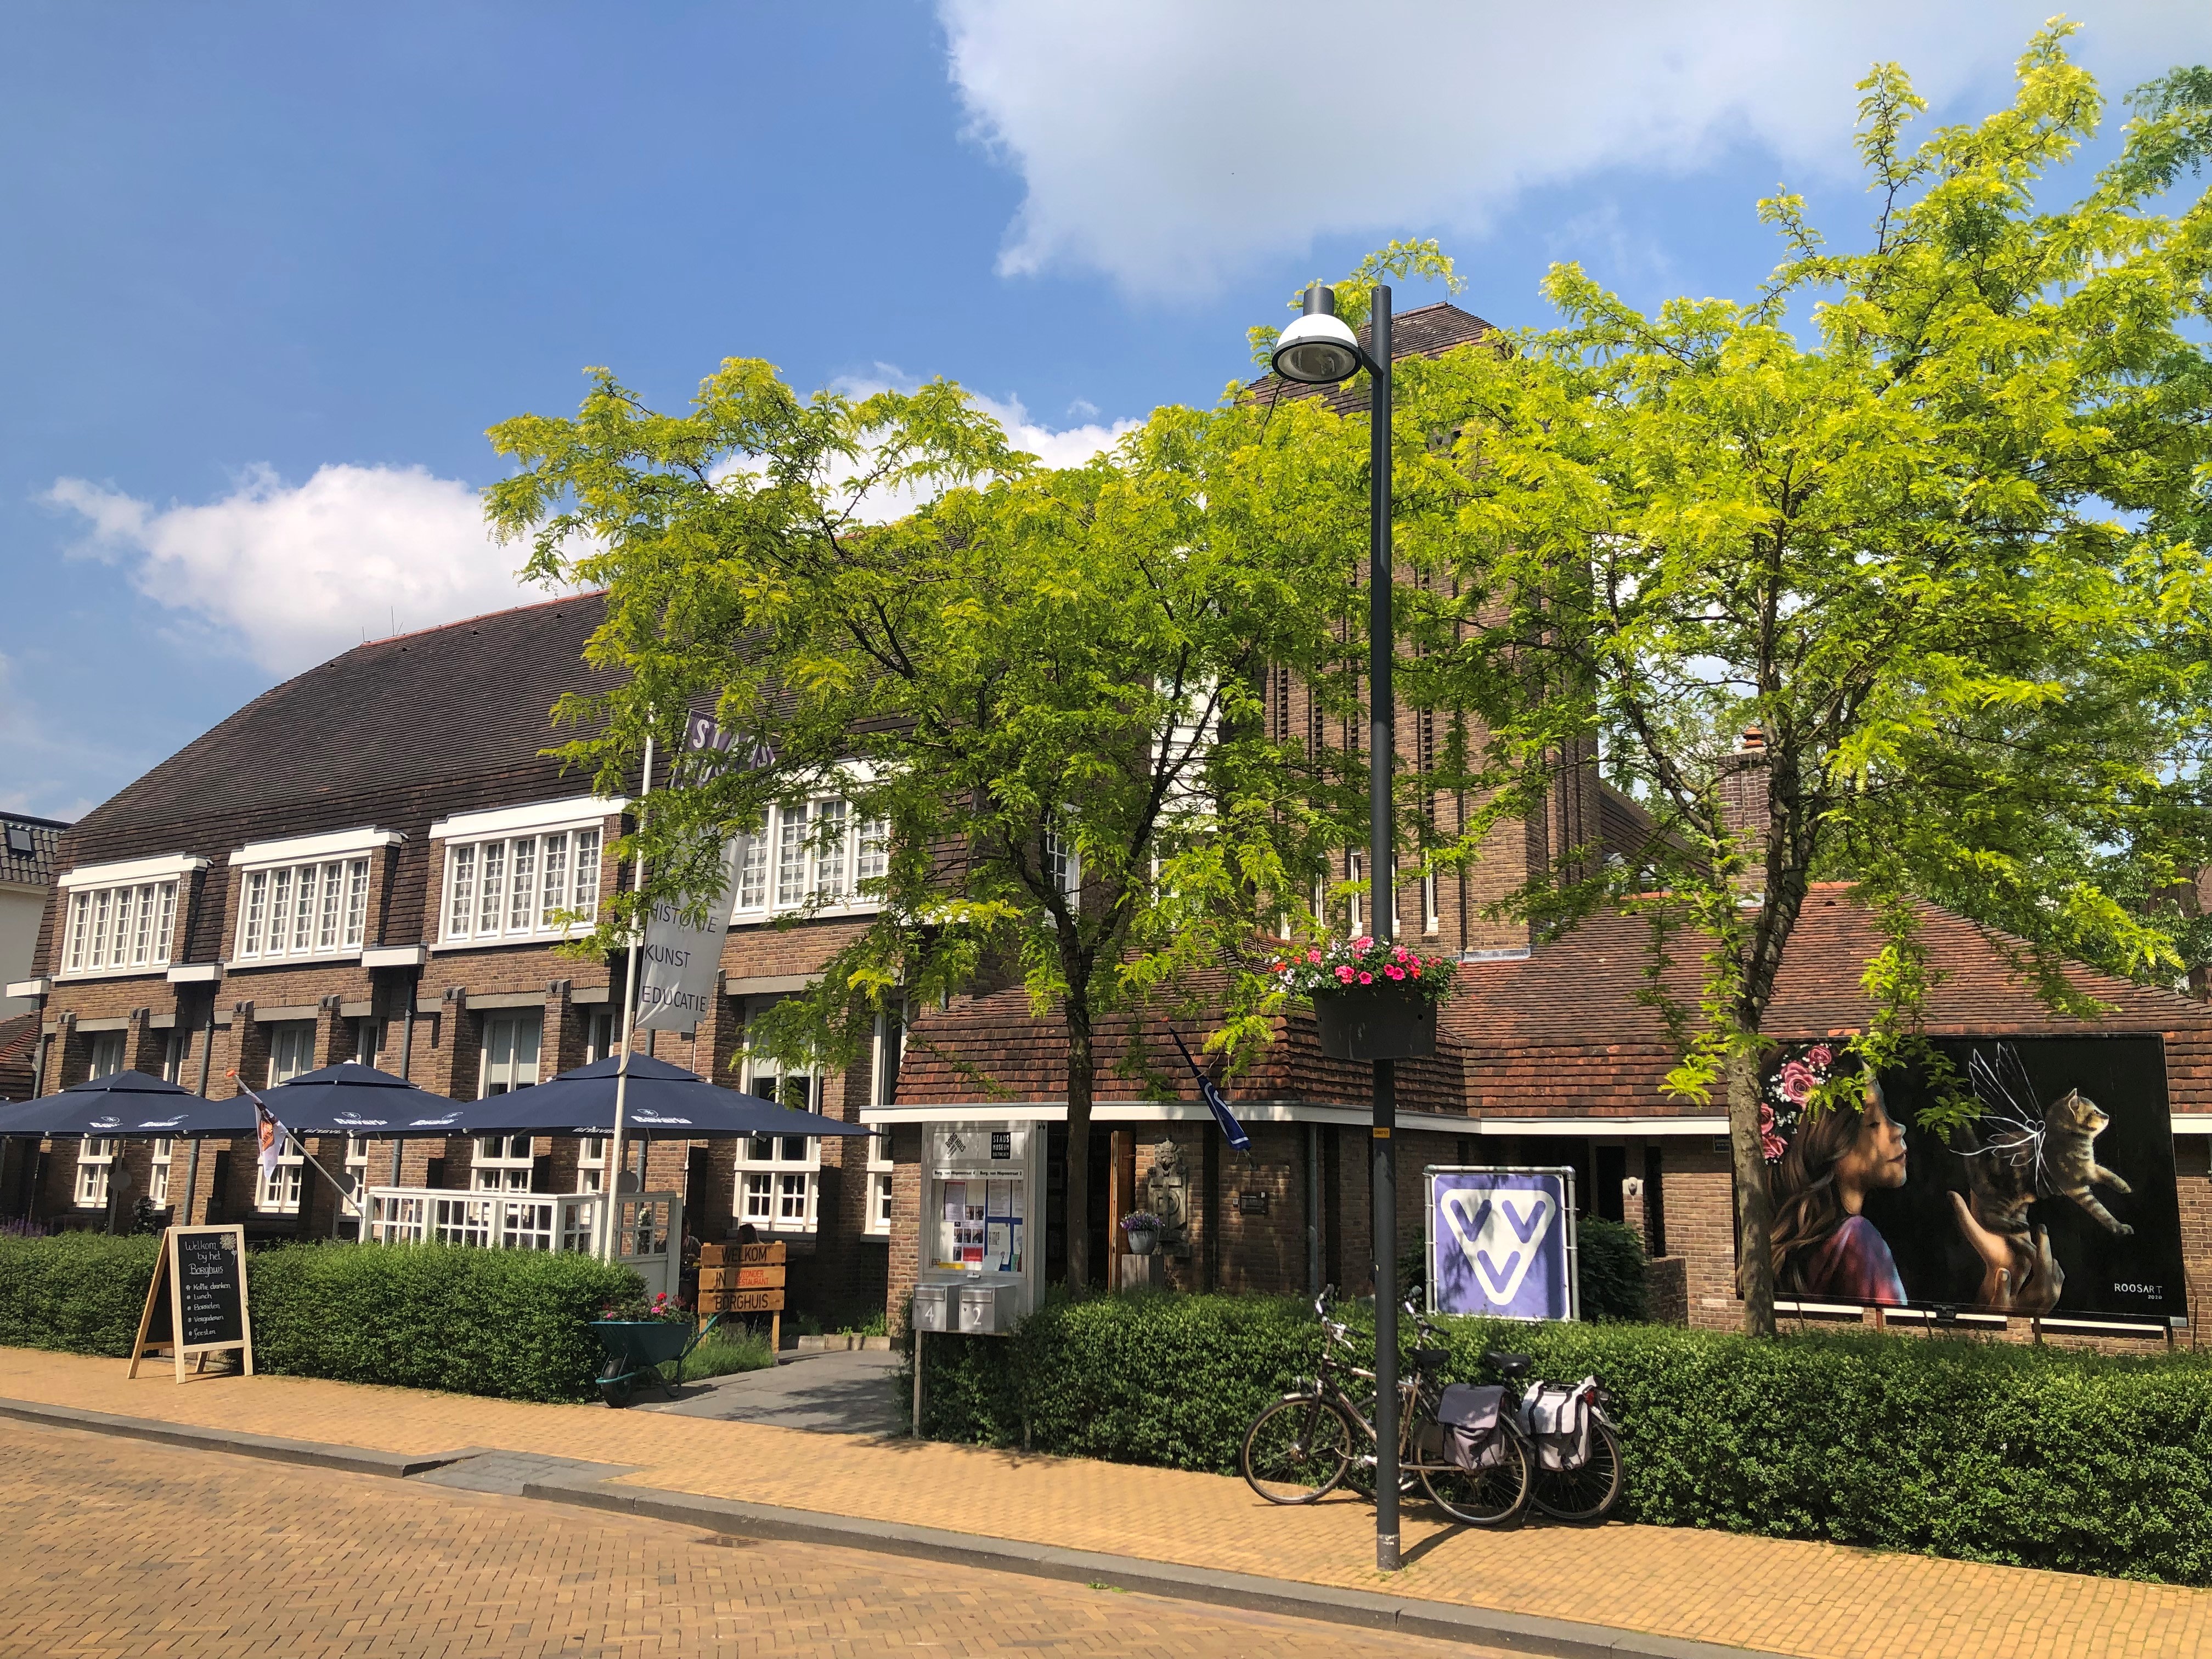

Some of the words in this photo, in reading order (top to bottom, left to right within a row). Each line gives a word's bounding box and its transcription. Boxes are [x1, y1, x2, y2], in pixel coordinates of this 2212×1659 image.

[645, 943, 691, 968] KUNST
[642, 986, 707, 1012] EDUCATIE
[631, 1115, 693, 1124] Bavaria
[945, 1132, 958, 1148] BORG
[955, 1138, 966, 1153] HUIS
[993, 1135, 1009, 1143] STADS
[185, 1240, 218, 1251] Welkom
[209, 1250, 222, 1260] het
[721, 1246, 767, 1261] WELKOM
[188, 1263, 224, 1278] Borghuis
[715, 1272, 726, 1286] IN
[194, 1291, 212, 1300] Lunch
[2114, 1283, 2163, 1294] ROOSART
[715, 1293, 768, 1310] BORGHUIS
[924, 1306, 934, 1323] 4
[973, 1307, 981, 1325] 2
